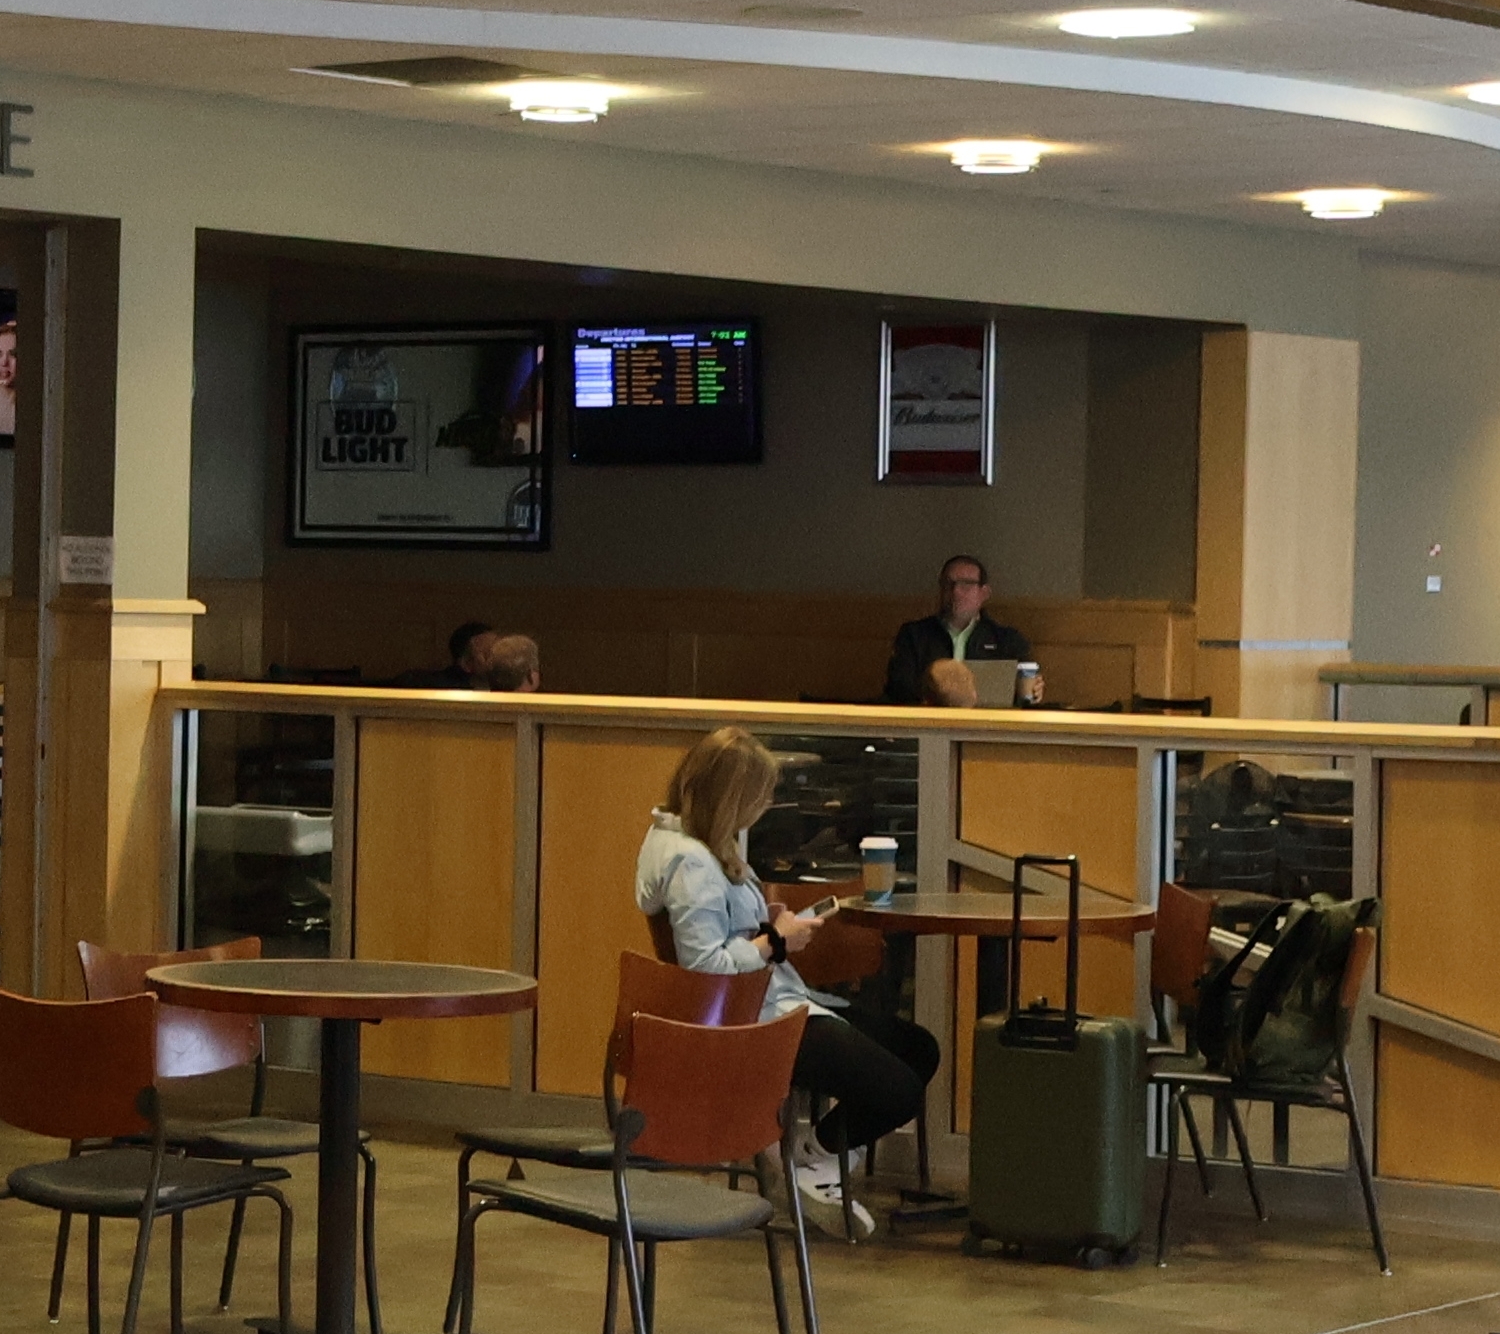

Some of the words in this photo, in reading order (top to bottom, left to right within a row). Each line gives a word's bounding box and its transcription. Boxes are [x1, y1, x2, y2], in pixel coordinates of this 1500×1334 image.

[577, 327, 646, 340] Departures
[334, 408, 397, 437] BUD
[322, 436, 409, 464] LIGHT
